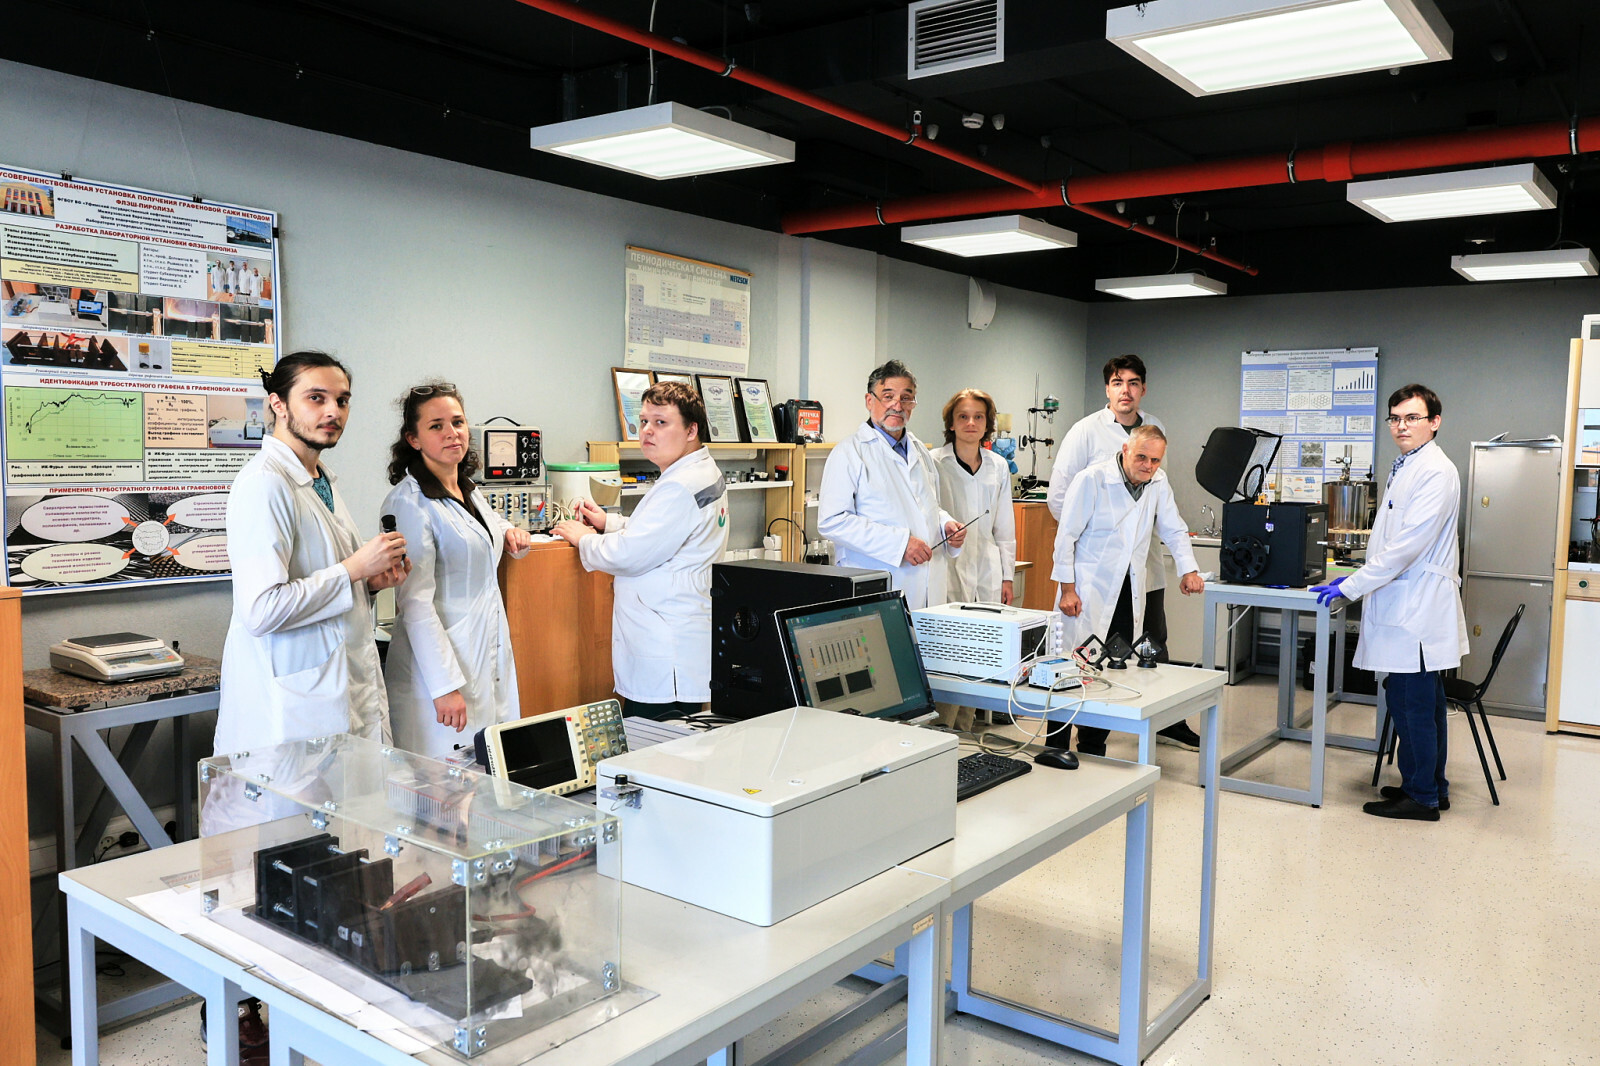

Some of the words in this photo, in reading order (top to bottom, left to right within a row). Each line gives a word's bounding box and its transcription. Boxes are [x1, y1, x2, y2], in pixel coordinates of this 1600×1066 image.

[0, 172, 94, 192] УСОВЕРШЕНСТВОВАННАЯ
[95, 187, 136, 199] УСТАНОВКА
[138, 195, 177, 205] ПОЛУЧЕНИЯ
[179, 202, 221, 213] ГРАФЕНОВОЙ
[242, 213, 270, 221] МЕТОДОМ
[116, 199, 174, 213] ФЛЭШ-ПИРОЛИЗА
[56, 224, 98, 234] РАЗРАБОТКА
[100, 229, 150, 242] ЛАБОРАТОРНОЙ
[152, 237, 187, 246] УСТАНОВКИ
[188, 242, 237, 253] ФЛЭШ-ПИРОЛИЗА
[631, 252, 694, 273] ПЕРИОДИЧЕСКАЯ
[695, 266, 727, 279] СИСТЕМА
[730, 275, 748, 285] NETZSCH
